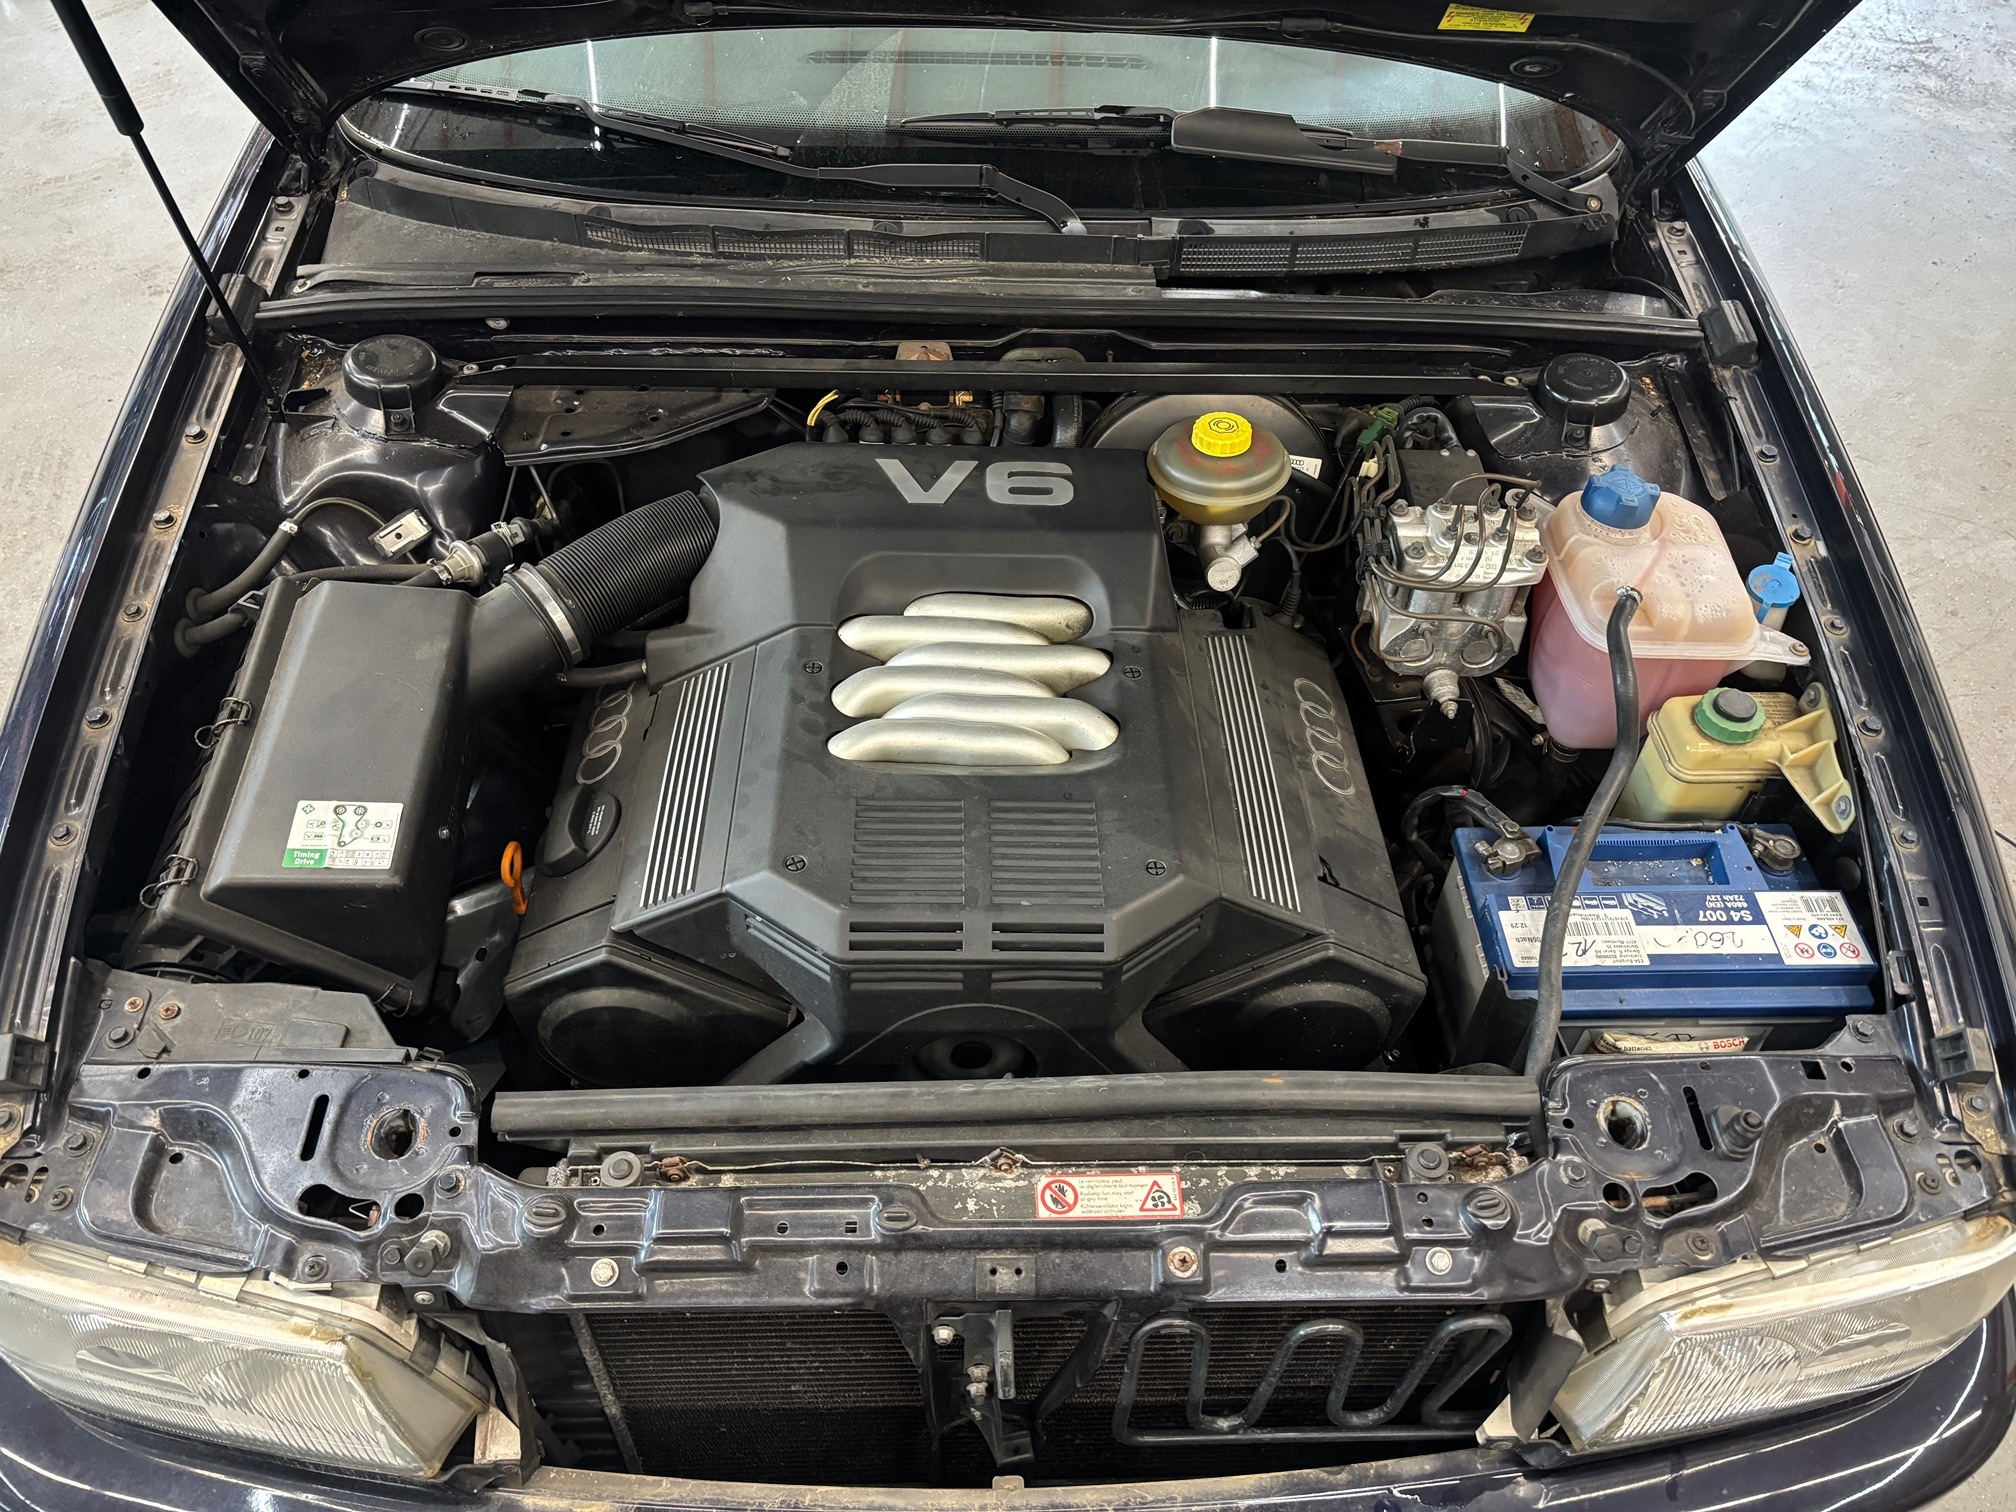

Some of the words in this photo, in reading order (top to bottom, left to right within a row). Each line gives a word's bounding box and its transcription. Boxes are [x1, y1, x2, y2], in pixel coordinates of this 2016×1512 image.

[874, 458, 1074, 506] V6
[293, 851, 320, 859] Timing
[1698, 910, 1727, 921] 007
[1730, 910, 1752, 921] S4
[1713, 1037, 1745, 1050] BOSCH
